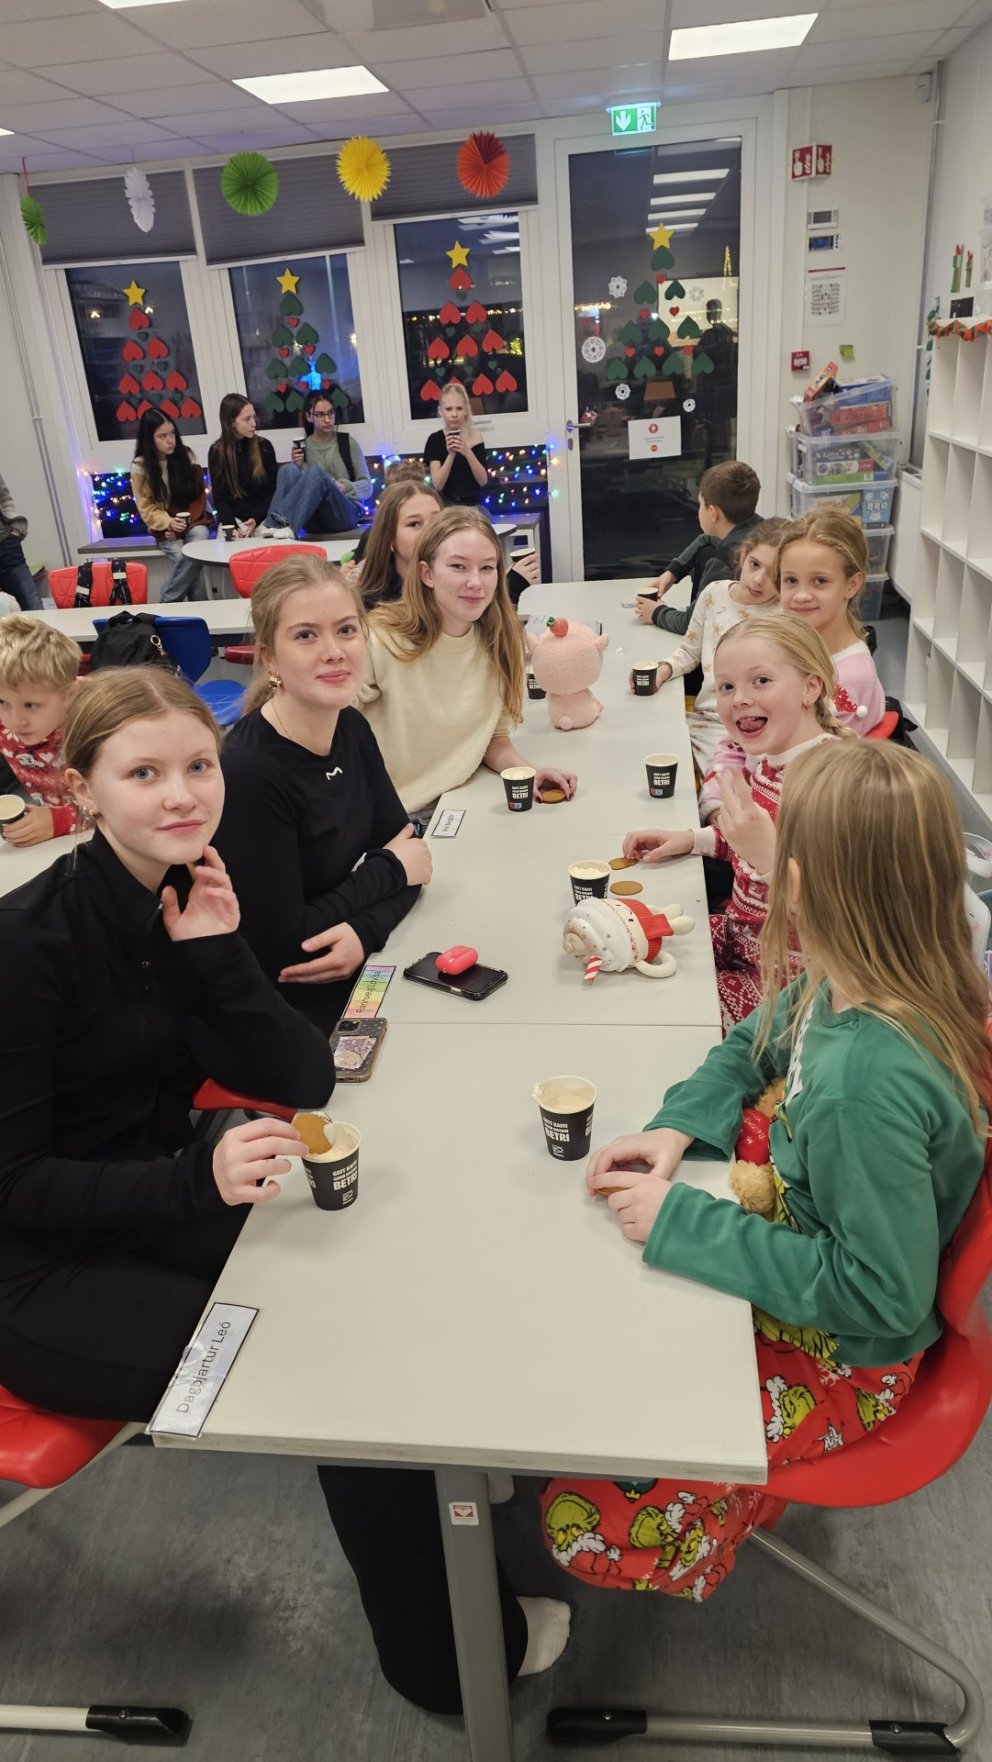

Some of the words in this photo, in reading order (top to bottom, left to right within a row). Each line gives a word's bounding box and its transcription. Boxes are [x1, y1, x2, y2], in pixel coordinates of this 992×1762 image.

[545, 1126, 570, 1143] BETRI
[333, 1169, 358, 1191] BETRI
[211, 1320, 231, 1344] Leó
